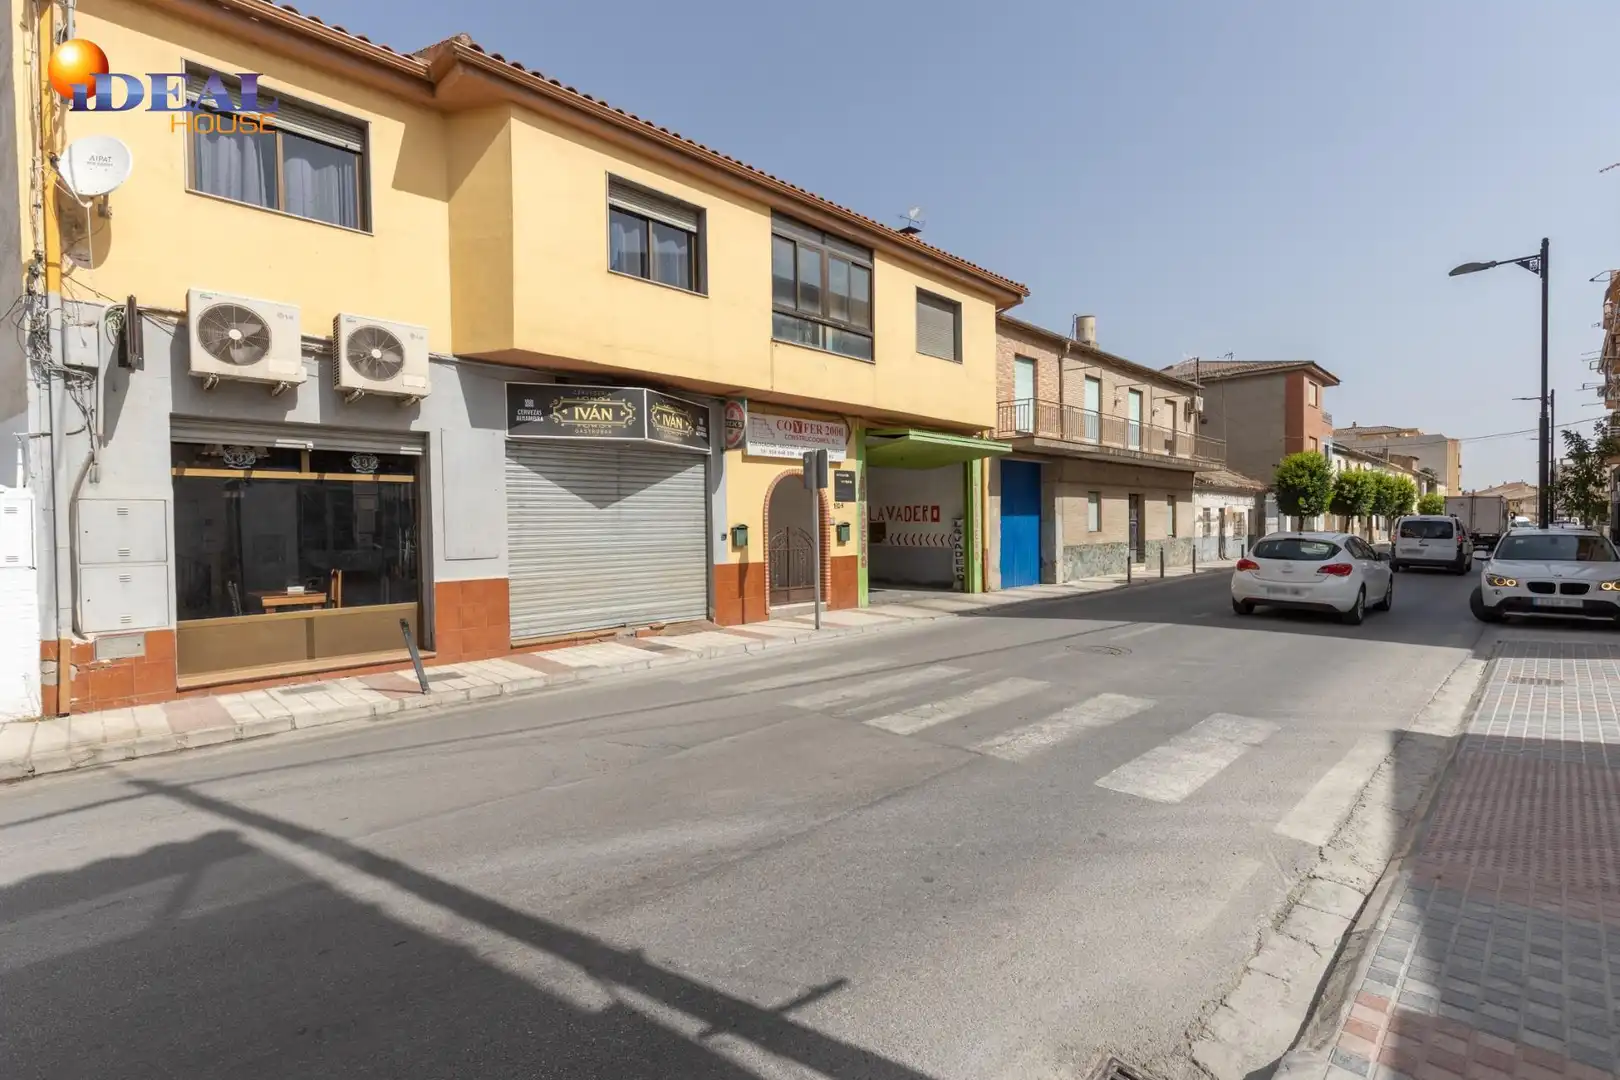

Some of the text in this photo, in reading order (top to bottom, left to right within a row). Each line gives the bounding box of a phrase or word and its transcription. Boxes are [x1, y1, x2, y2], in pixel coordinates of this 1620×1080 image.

[574, 404, 613, 421] IVÁN
[662, 412, 683, 430] IVÁN
[869, 505, 940, 522] LAVADERO
[953, 520, 965, 582] LAVADERO
